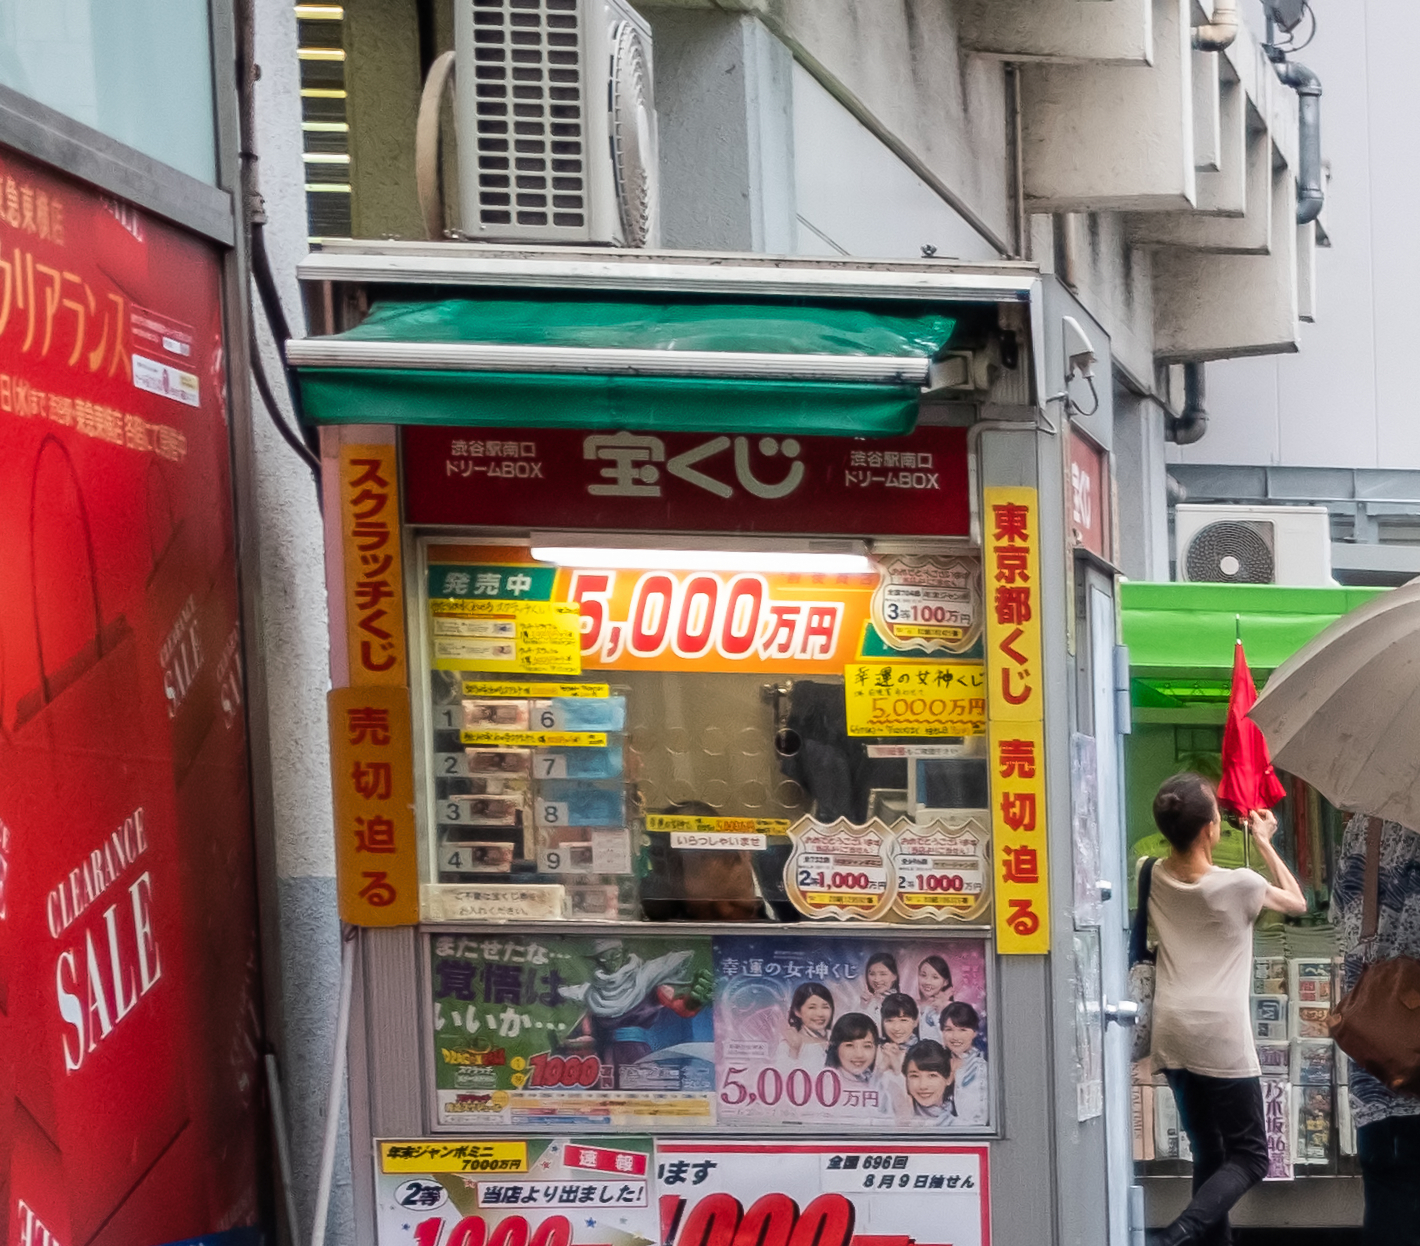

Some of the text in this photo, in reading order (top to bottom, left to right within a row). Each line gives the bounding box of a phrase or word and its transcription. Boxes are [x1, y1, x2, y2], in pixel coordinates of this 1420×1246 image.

[451, 440, 536, 458] 渋谷駅南口
[445, 459, 544, 480] ドリームBOX
[583, 435, 804, 498] 宝くじ
[850, 451, 932, 470] 渋谷駅南口
[844, 469, 940, 490] ドリームBOX
[349, 458, 398, 672] スクラッチくじ
[443, 571, 532, 597] 発売中
[992, 502, 1033, 706] 東京都くじ
[569, 571, 843, 662] 5,000万円
[854, 666, 985, 688] 幸運の女神くじ
[871, 697, 986, 719] 5,000万円
[443, 712, 453, 726] 1
[541, 711, 555, 728] 6
[444, 757, 458, 774] 2
[543, 759, 555, 775] 7
[347, 704, 398, 909] 売切迫る
[447, 804, 460, 821] 3
[545, 806, 558, 823] 8
[998, 739, 1040, 937] 売切迫る
[448, 852, 463, 869] 4
[547, 853, 560, 870] 9
[47, 806, 149, 939] CLEARANCE
[55, 871, 162, 1075] SALE
[722, 957, 859, 980] 幸運の女神くじ
[436, 960, 567, 1008] 覚悟は
[720, 1067, 880, 1108] 5,000万円
[387, 1145, 494, 1160] 年末ジャンボミニ
[578, 1149, 635, 1173] 速報
[462, 1159, 522, 1171] 7000万円
[863, 1174, 975, 1190] 8月9日抽せん
[401, 1182, 443, 1207] 2等
[482, 1185, 643, 1205] 当店より出ました!
